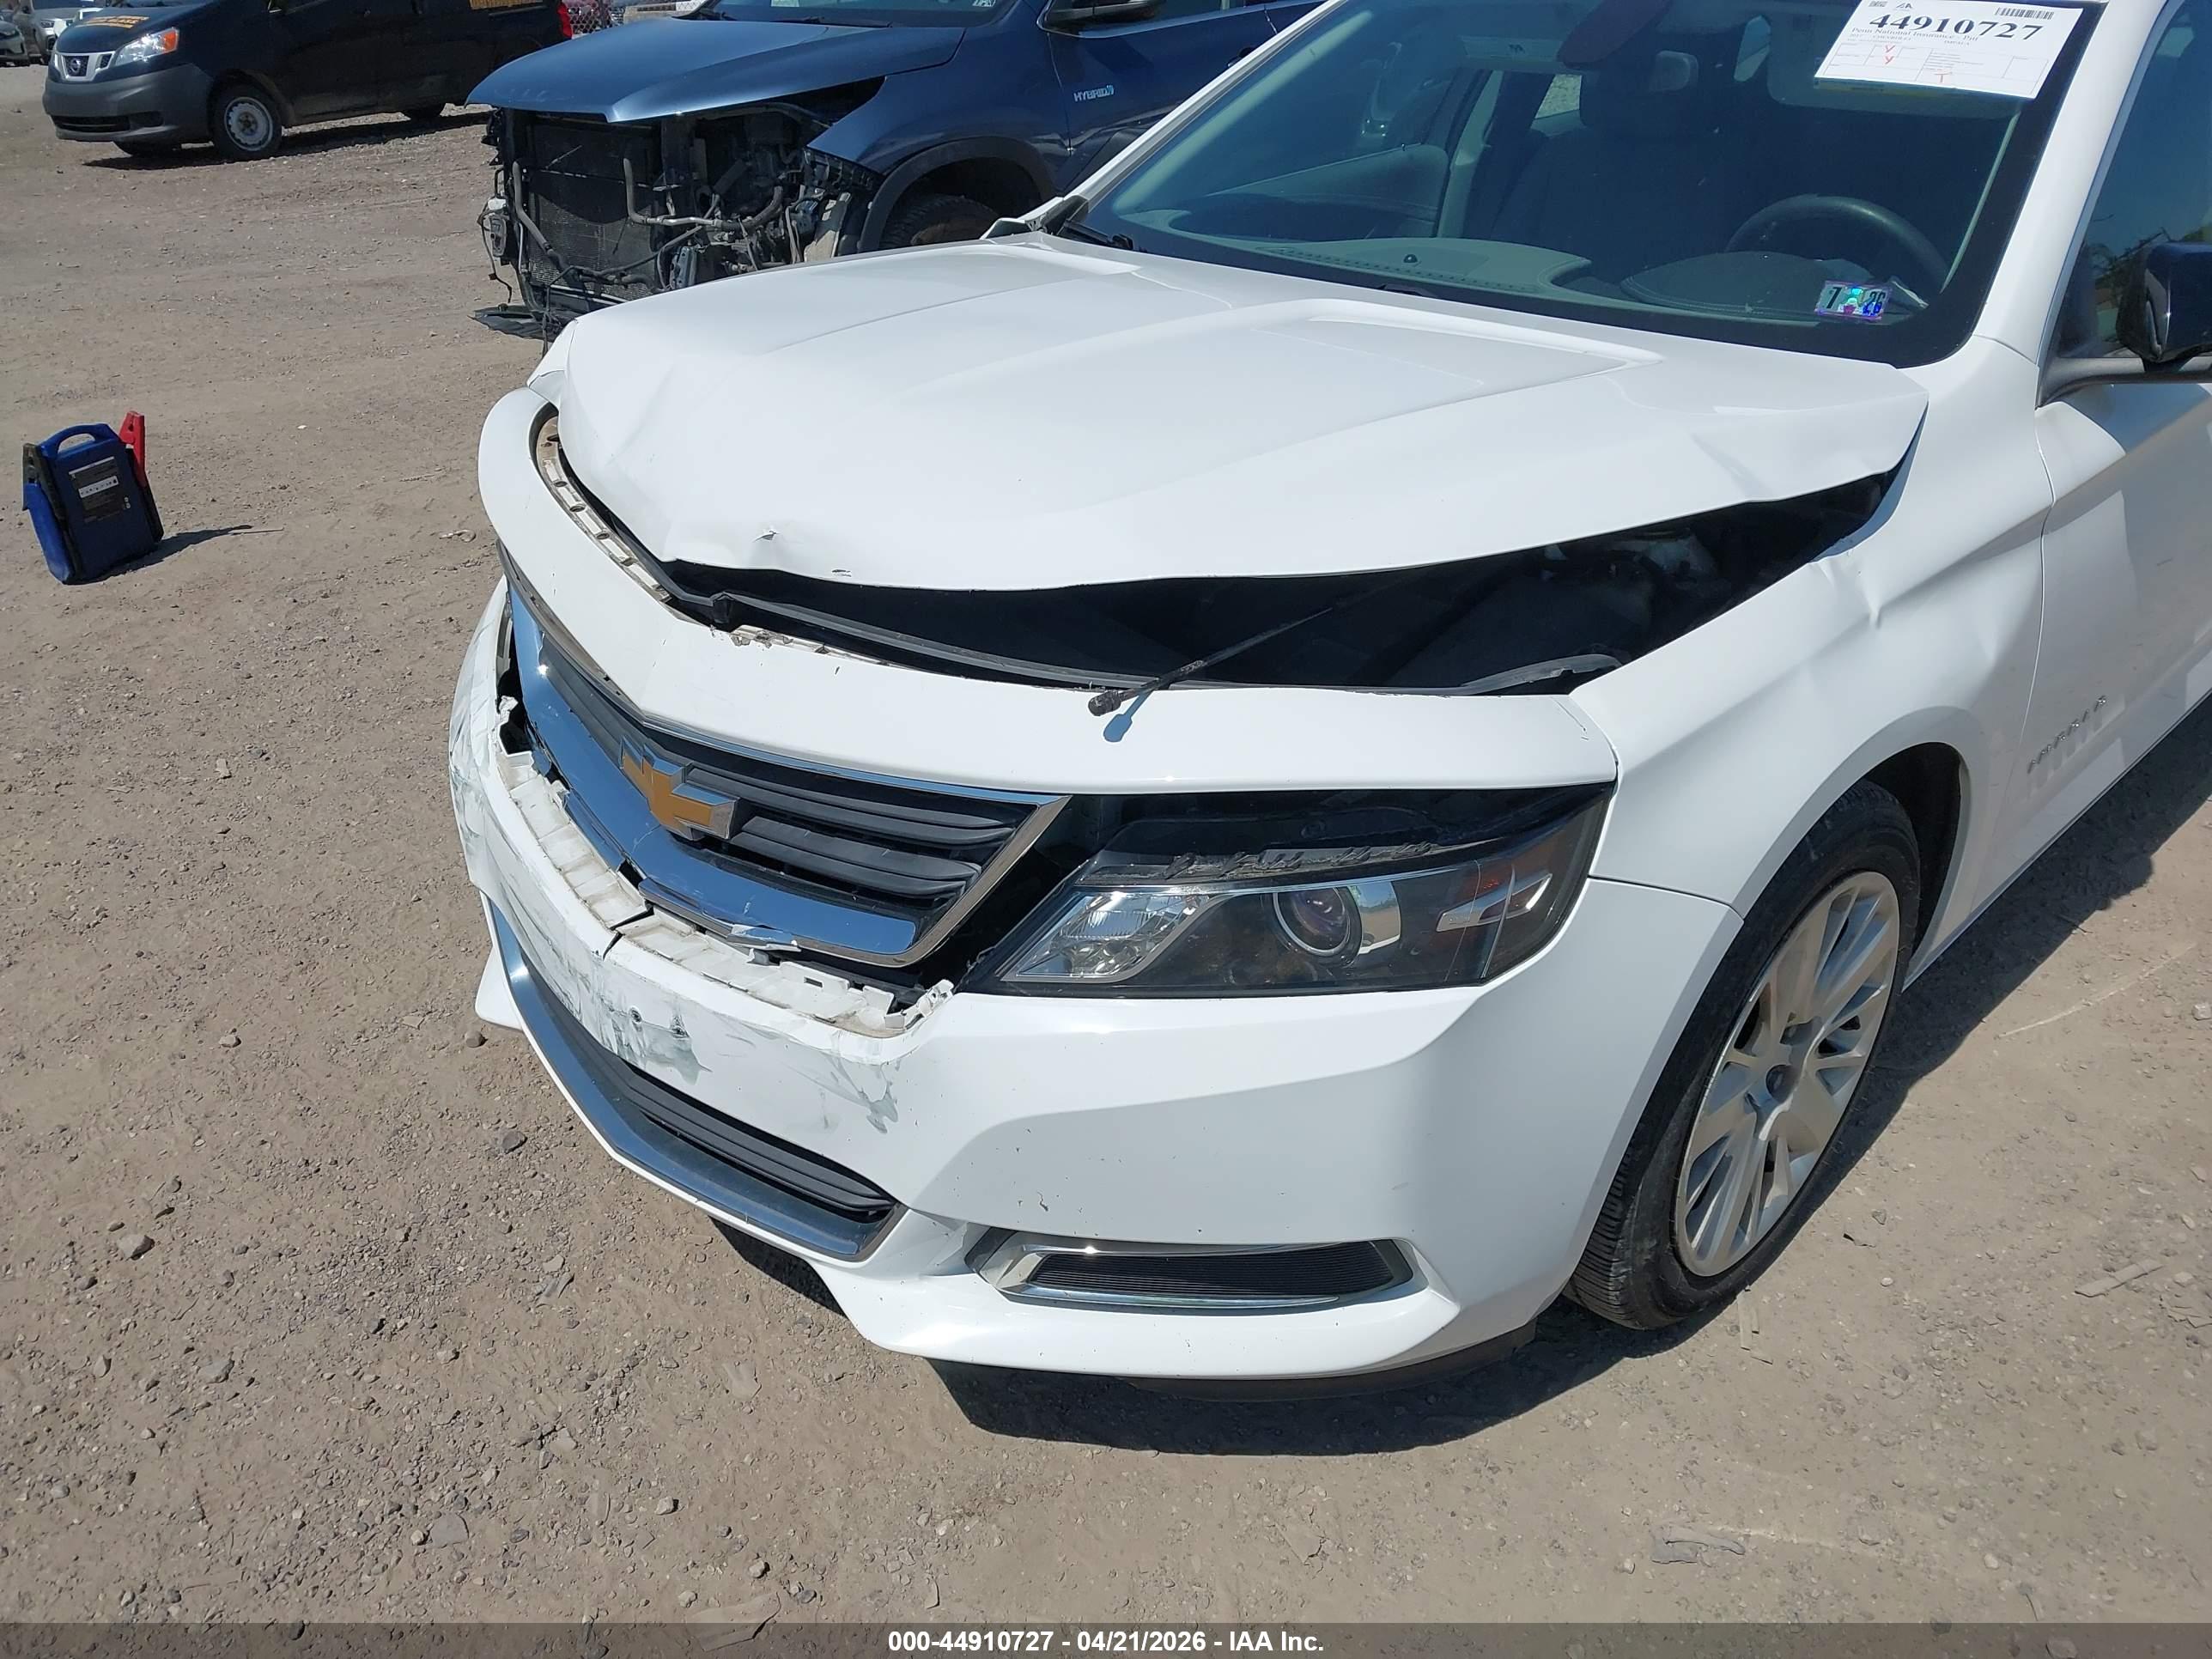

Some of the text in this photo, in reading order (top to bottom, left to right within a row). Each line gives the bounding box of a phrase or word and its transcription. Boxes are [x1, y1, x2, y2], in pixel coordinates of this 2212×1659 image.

[1869, 14, 2044, 40] 44910727
[1073, 87, 1110, 102] HYBRID
[1826, 286, 1843, 309] 7
